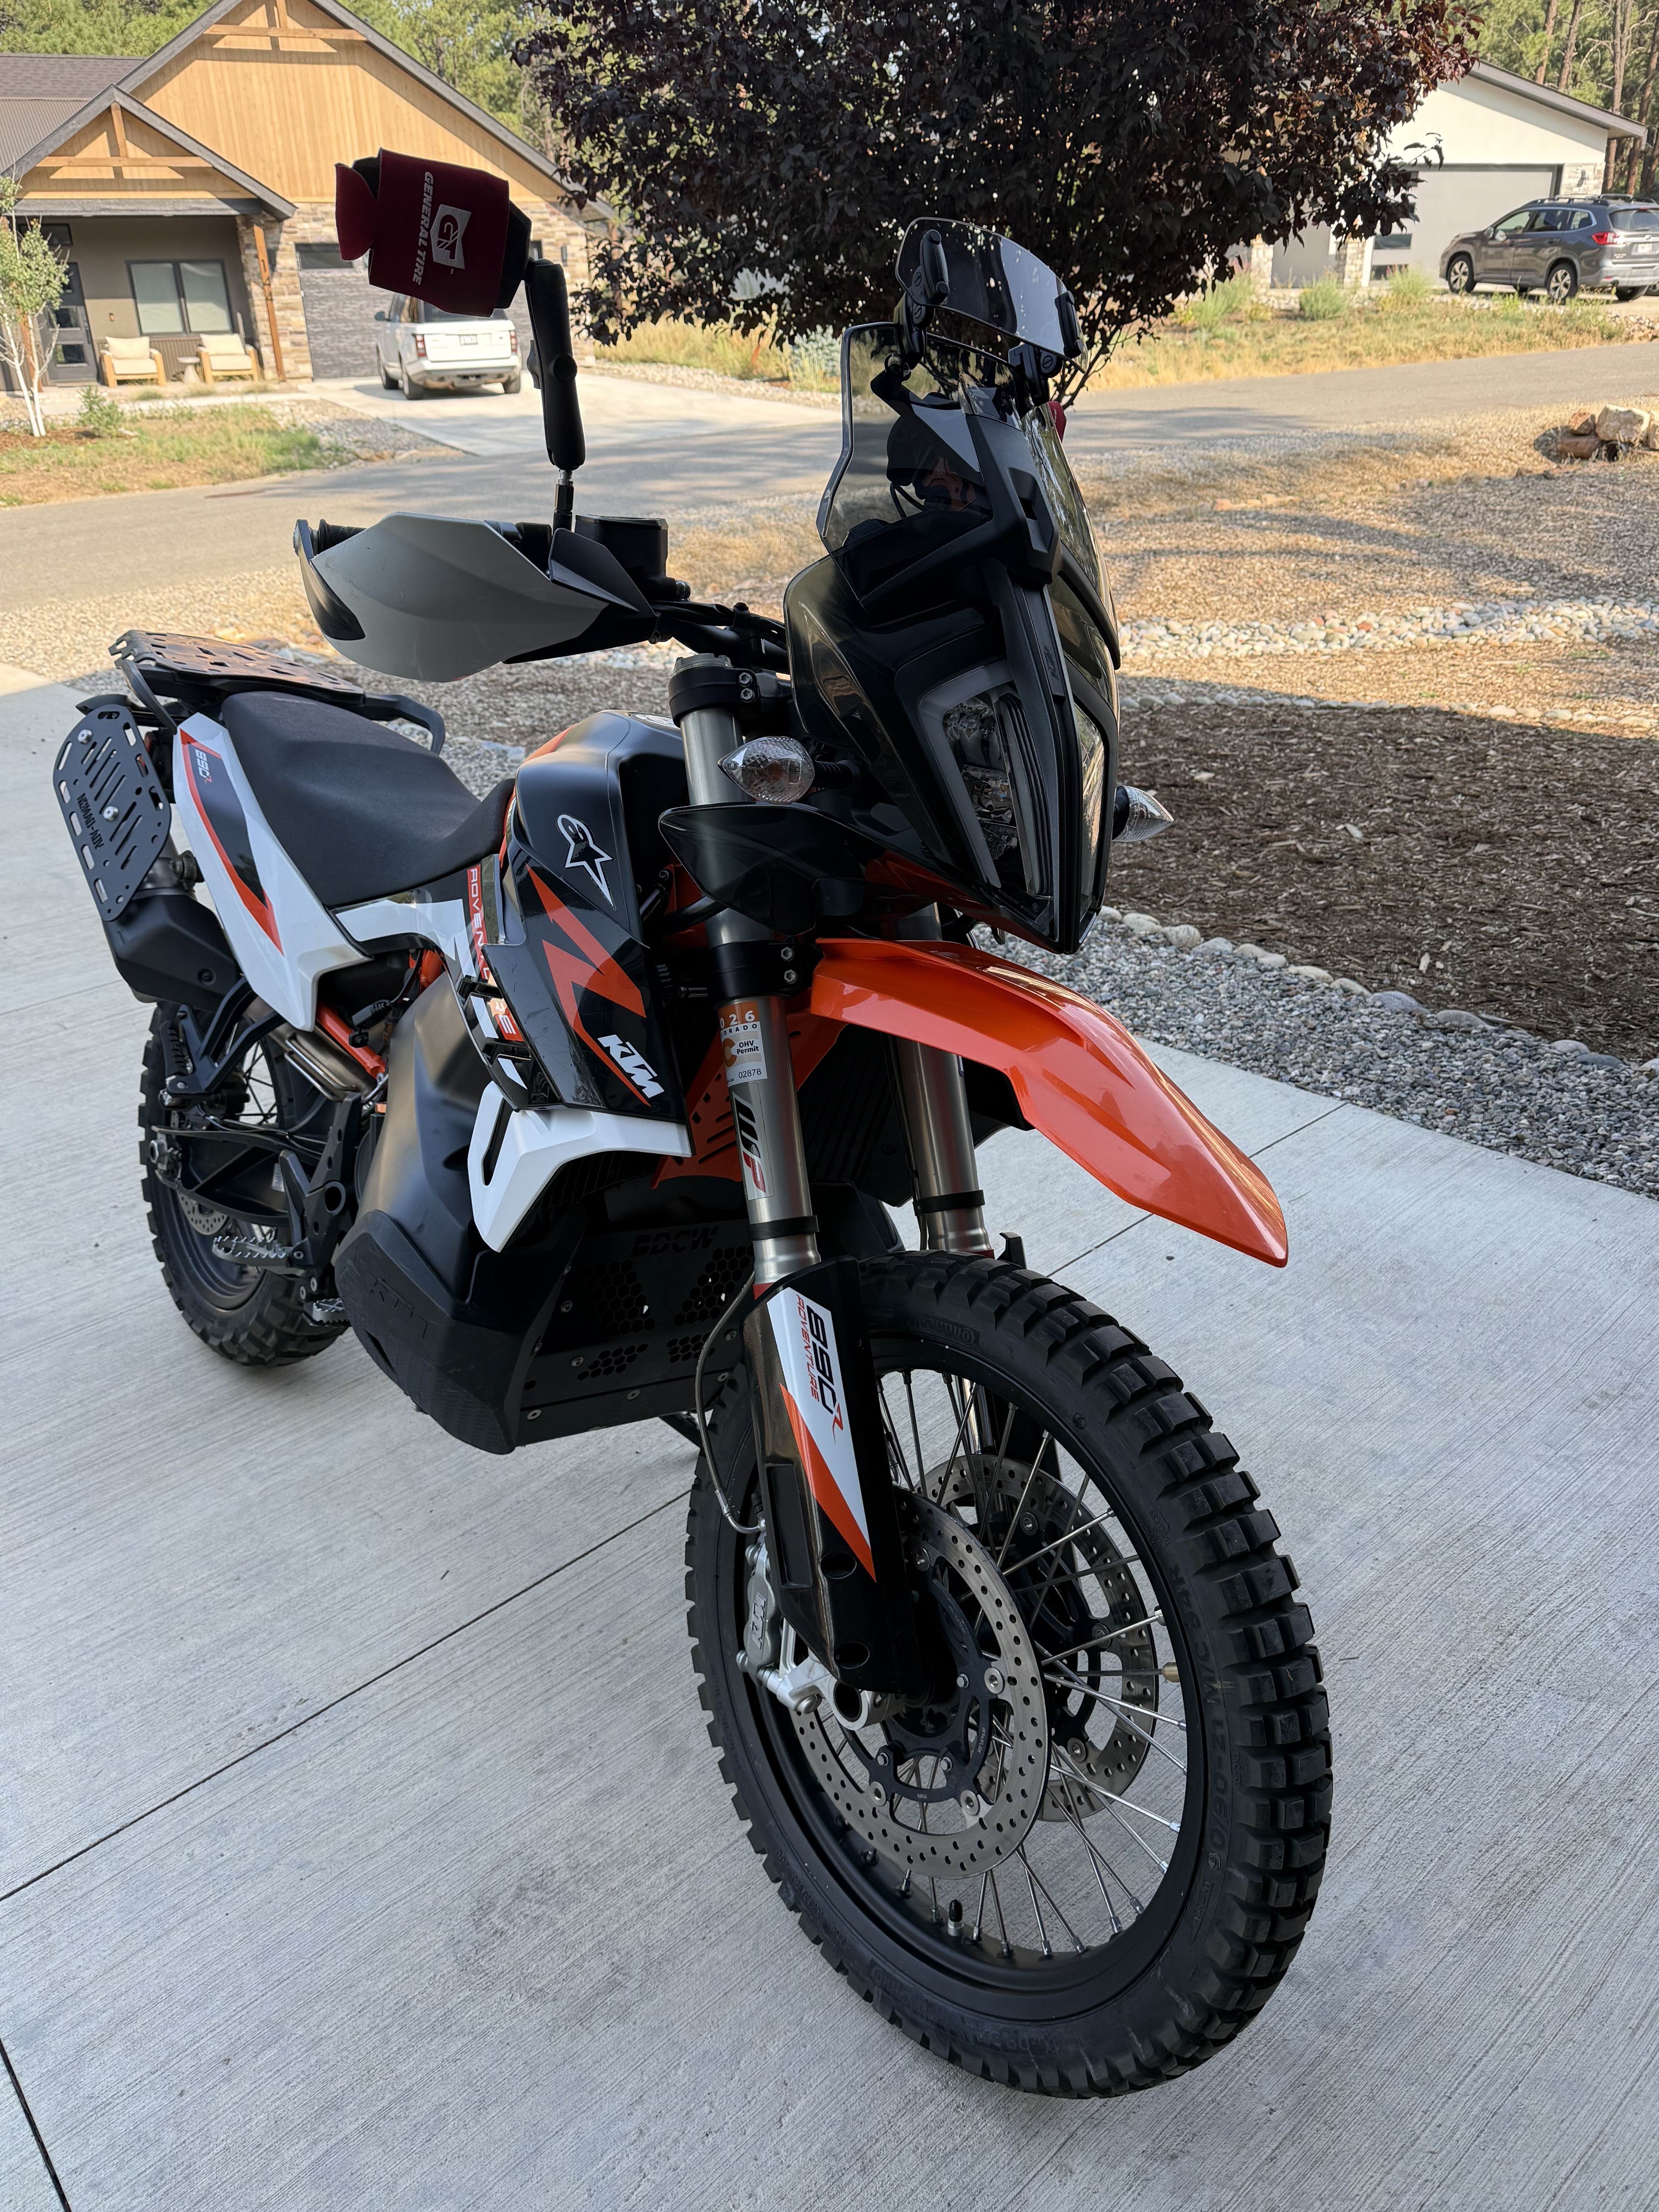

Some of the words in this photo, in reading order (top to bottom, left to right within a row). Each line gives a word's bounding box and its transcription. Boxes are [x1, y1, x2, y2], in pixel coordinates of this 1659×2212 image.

[419, 172, 434, 246] GENERAL
[413, 250, 426, 285] TIRE
[598, 1034, 665, 1099] KTM
[737, 1046, 759, 1054] Permit
[738, 1068, 761, 1078] 02878
[796, 1295, 820, 1402] ADVENTURE
[752, 1592, 766, 1649] KTM
[1207, 1718, 1228, 1870] 90/90-21
